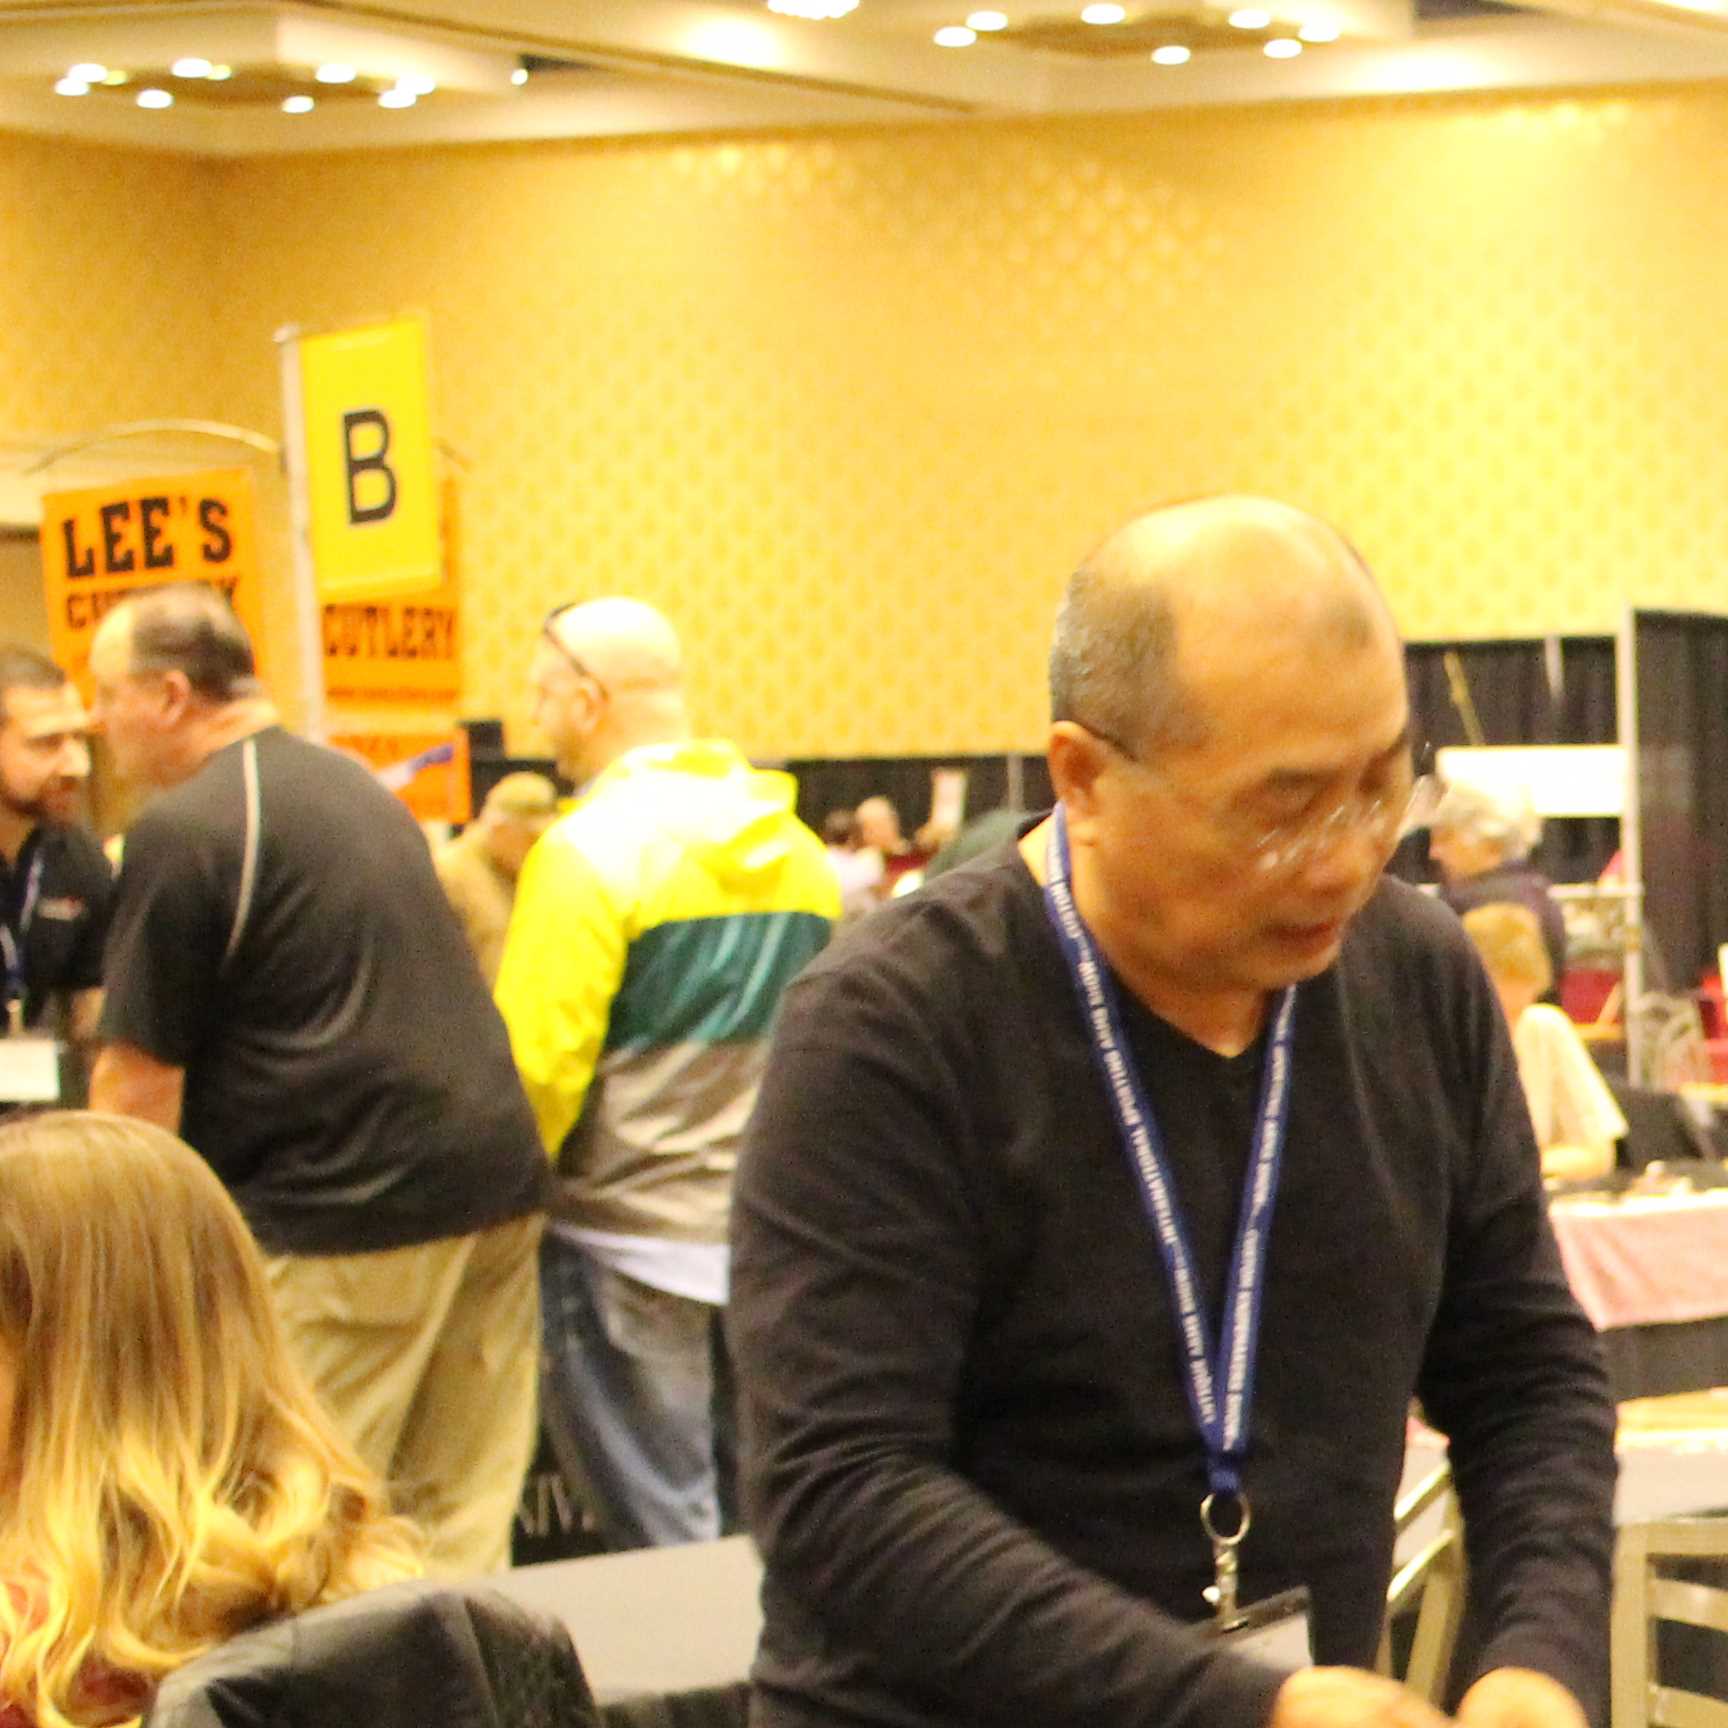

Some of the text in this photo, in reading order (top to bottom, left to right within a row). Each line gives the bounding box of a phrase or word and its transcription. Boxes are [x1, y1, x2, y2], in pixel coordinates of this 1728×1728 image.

[342, 408, 399, 525] B
[62, 496, 232, 580] LEE'S
[324, 604, 456, 658] CUTLERY
